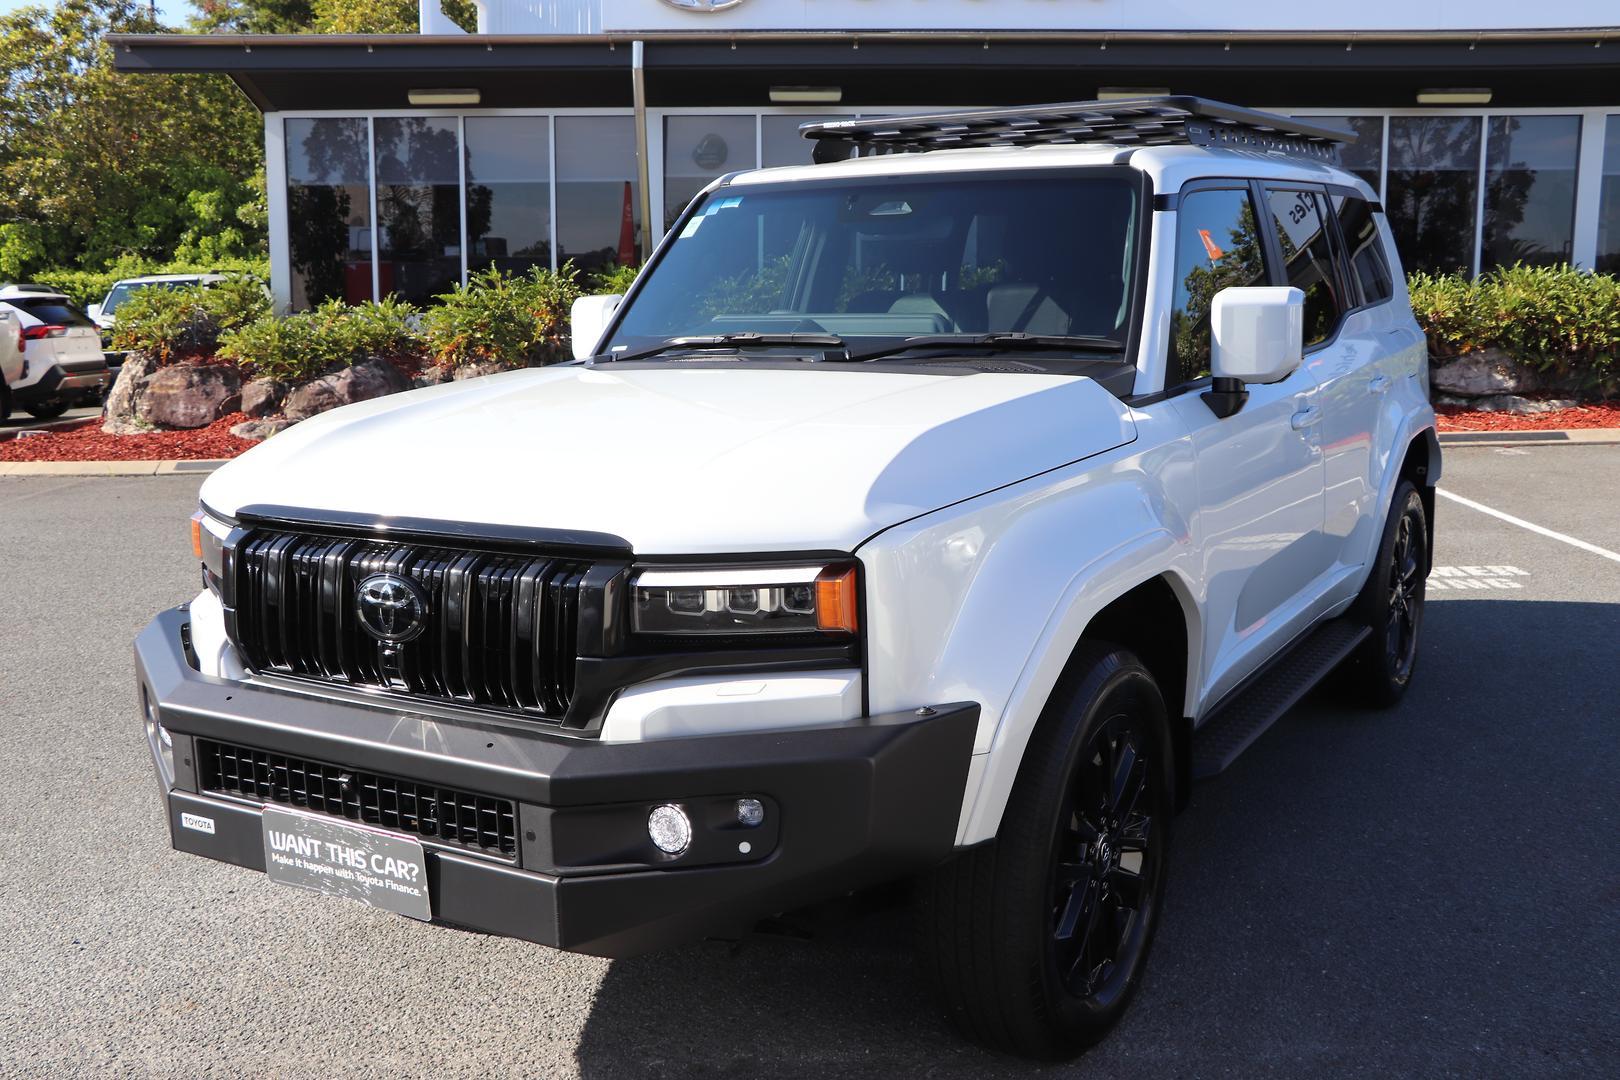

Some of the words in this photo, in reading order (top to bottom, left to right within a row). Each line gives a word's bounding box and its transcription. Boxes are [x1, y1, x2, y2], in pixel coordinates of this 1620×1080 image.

[184, 816, 212, 830] TOYOTA
[269, 831, 322, 858] WANT
[325, 842, 367, 869] THIS
[371, 854, 420, 882] CAR?
[271, 852, 294, 866] Make
[296, 858, 303, 868] it
[304, 860, 334, 875] happen
[335, 868, 355, 880] with
[355, 872, 385, 888] Toyota
[385, 879, 422, 897] Finance.
